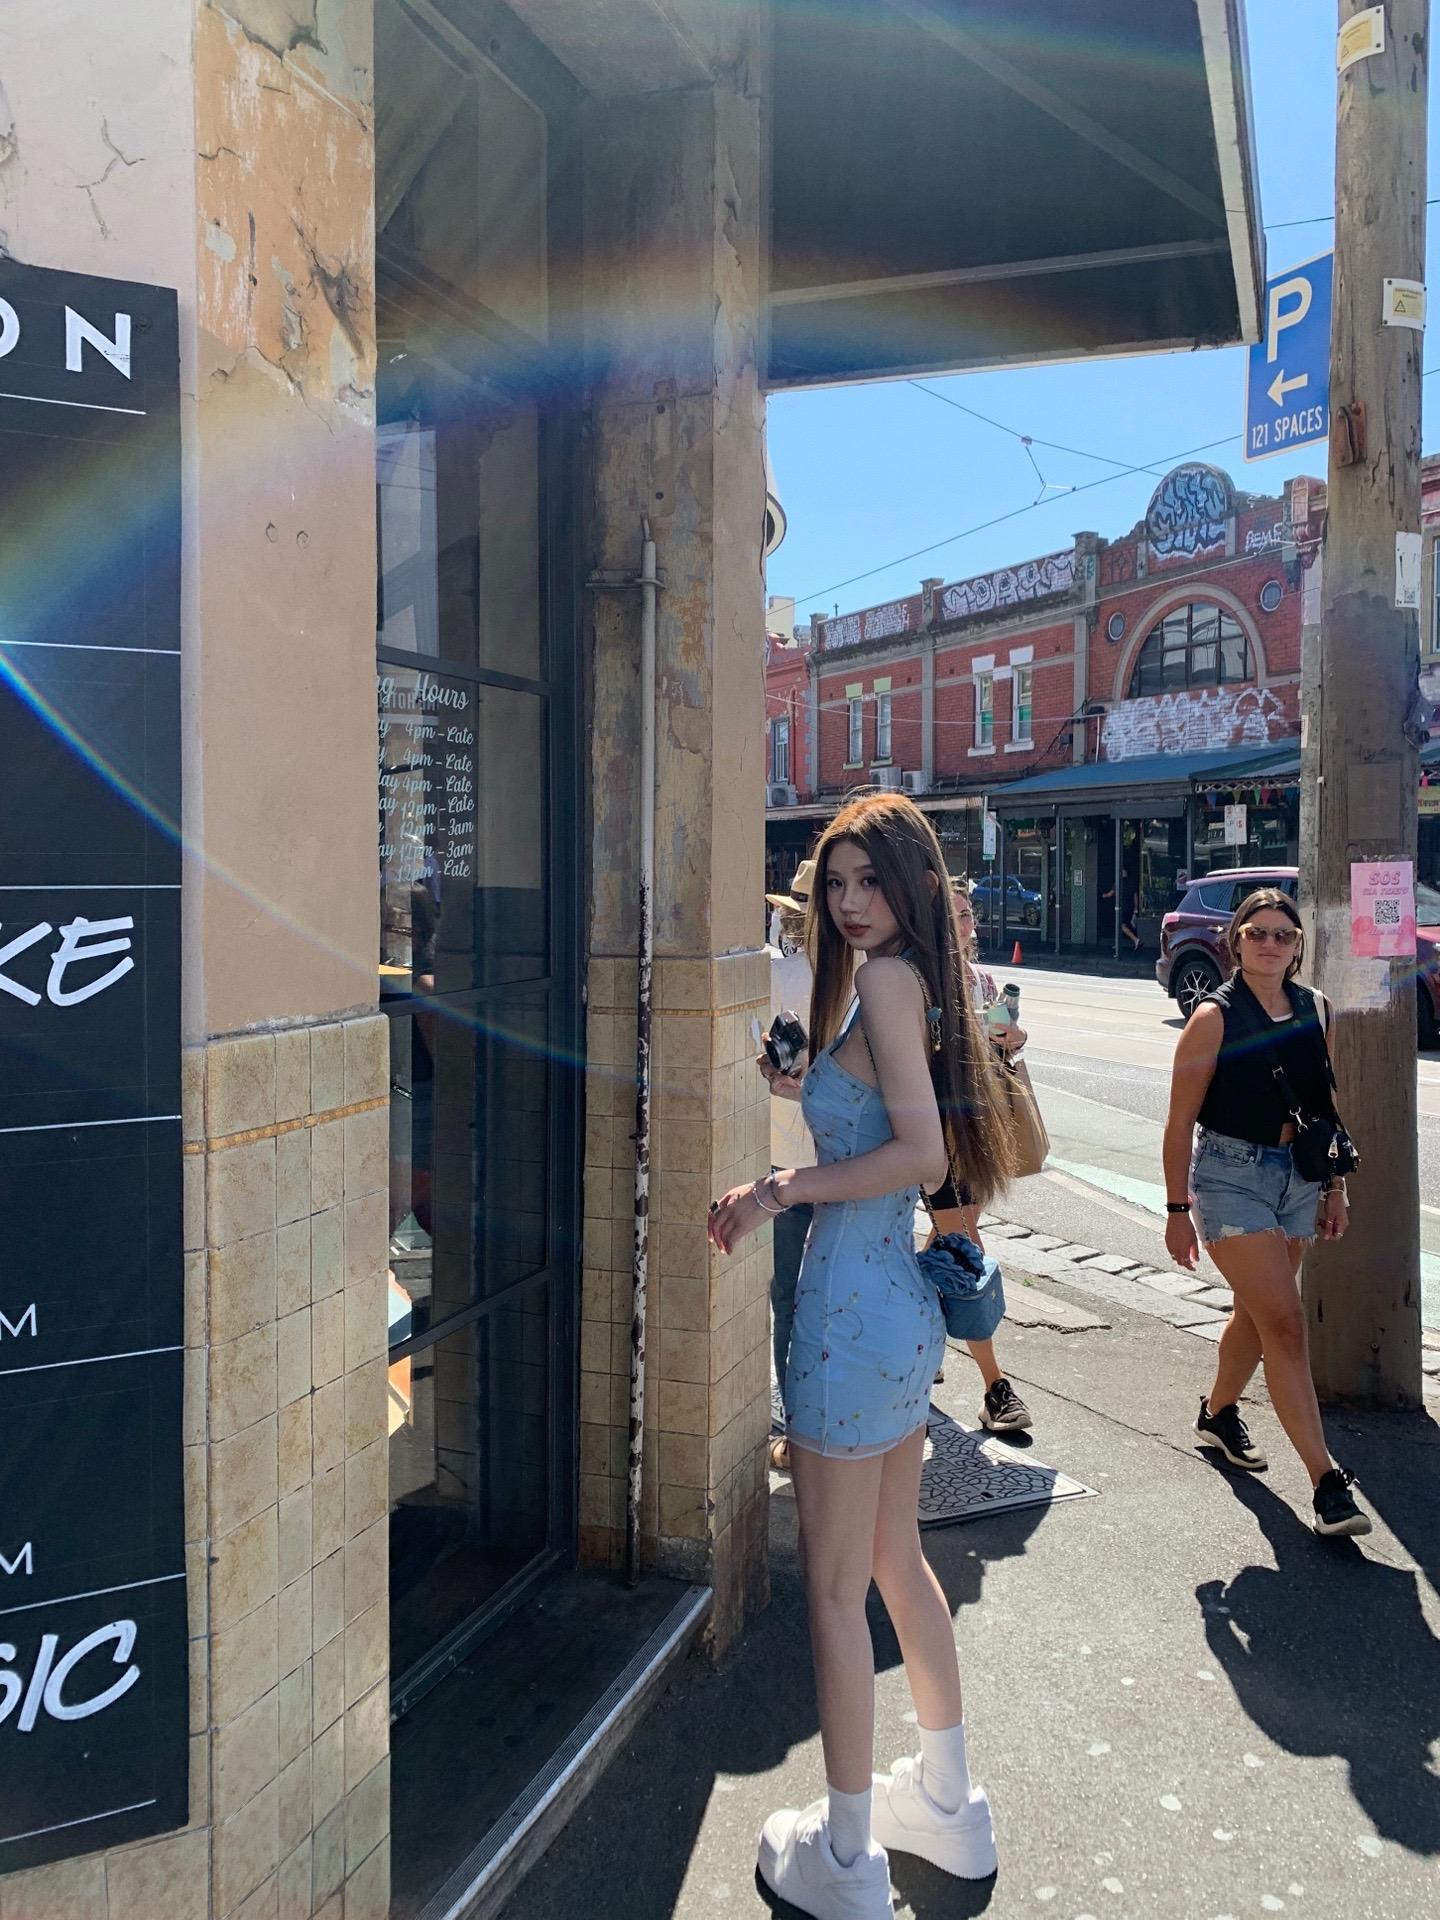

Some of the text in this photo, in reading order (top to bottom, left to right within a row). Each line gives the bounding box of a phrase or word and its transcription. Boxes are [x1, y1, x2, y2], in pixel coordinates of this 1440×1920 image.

[1267, 277, 1313, 364] P
[1252, 405, 1323, 449] 121 SPACES
[414, 671, 470, 710] Hours
[405, 720, 436, 744] 4pm
[446, 726, 474, 745] Late
[403, 747, 434, 771] 4pm
[445, 753, 473, 773] Late
[402, 774, 433, 798] 4pm
[445, 775, 473, 793] Late
[401, 800, 437, 822] 12pm
[447, 794, 475, 813] Late
[447, 817, 474, 836] 3am
[446, 840, 473, 858] 3am
[443, 859, 471, 878] Late
